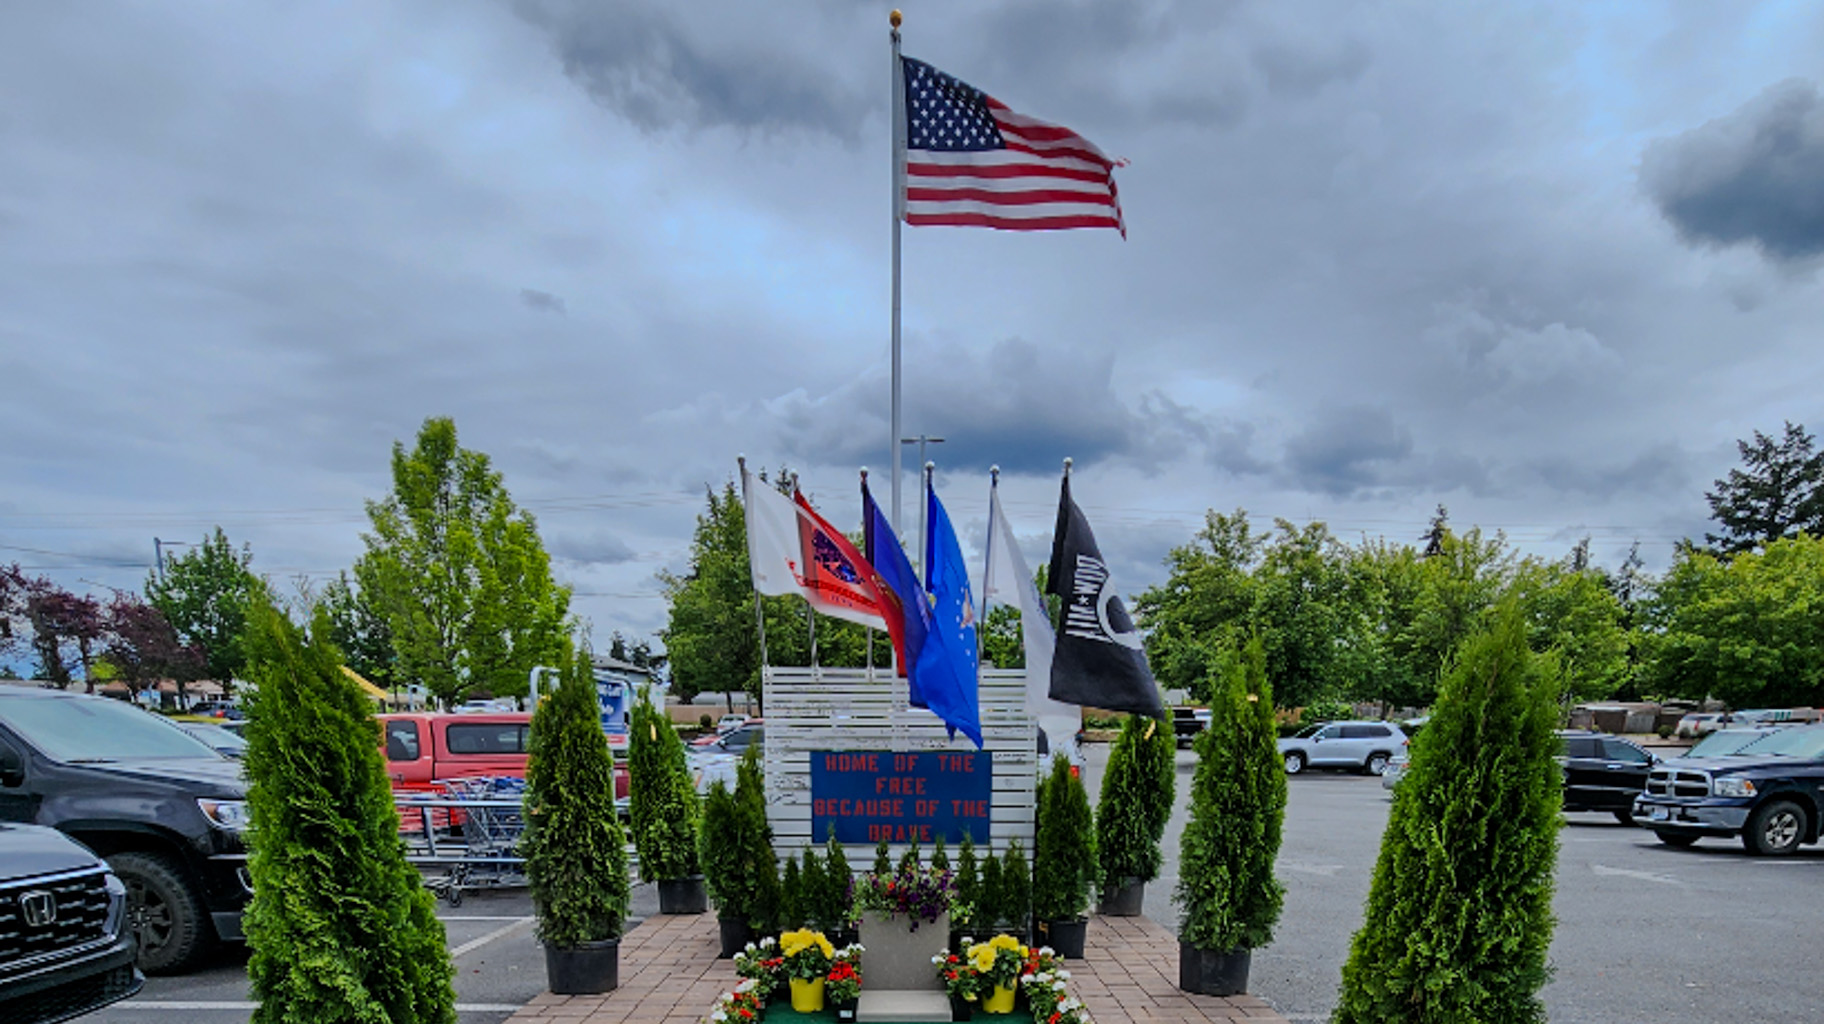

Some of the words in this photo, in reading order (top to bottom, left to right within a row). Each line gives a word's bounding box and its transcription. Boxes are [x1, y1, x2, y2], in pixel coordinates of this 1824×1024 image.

[825, 754, 879, 772] HOME
[894, 754, 919, 772] OF
[938, 755, 975, 772] THE
[876, 777, 927, 795] FREE
[813, 798, 904, 817] BECAUSE
[915, 799, 940, 817] OF
[951, 800, 988, 817] THE
[868, 824, 932, 842] BRAVE
